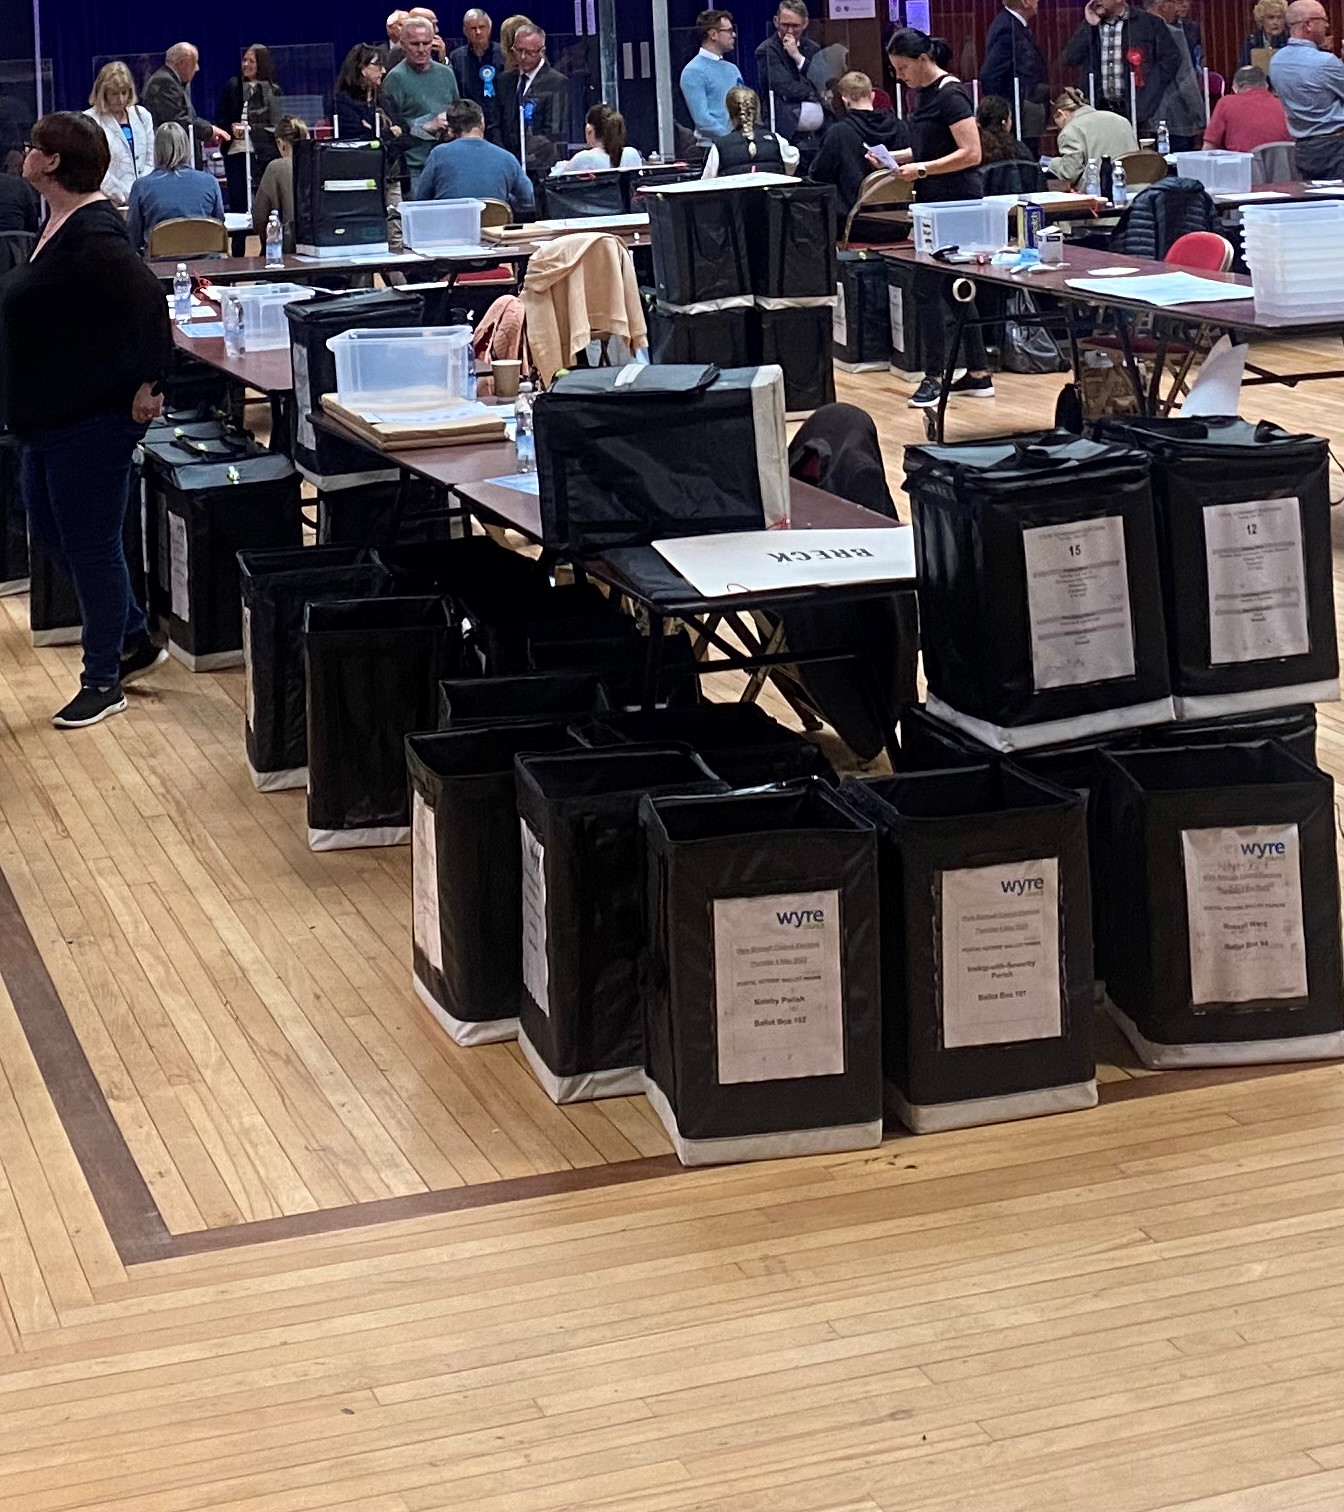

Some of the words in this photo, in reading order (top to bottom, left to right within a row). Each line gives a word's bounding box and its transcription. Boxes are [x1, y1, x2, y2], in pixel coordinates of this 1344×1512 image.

[1246, 523, 1258, 536] 12
[767, 547, 875, 563] BRECK
[1068, 544, 1082, 557] 15
[1240, 841, 1286, 859] wyre
[1000, 876, 1045, 897] wyre
[776, 908, 825, 929] wyre
